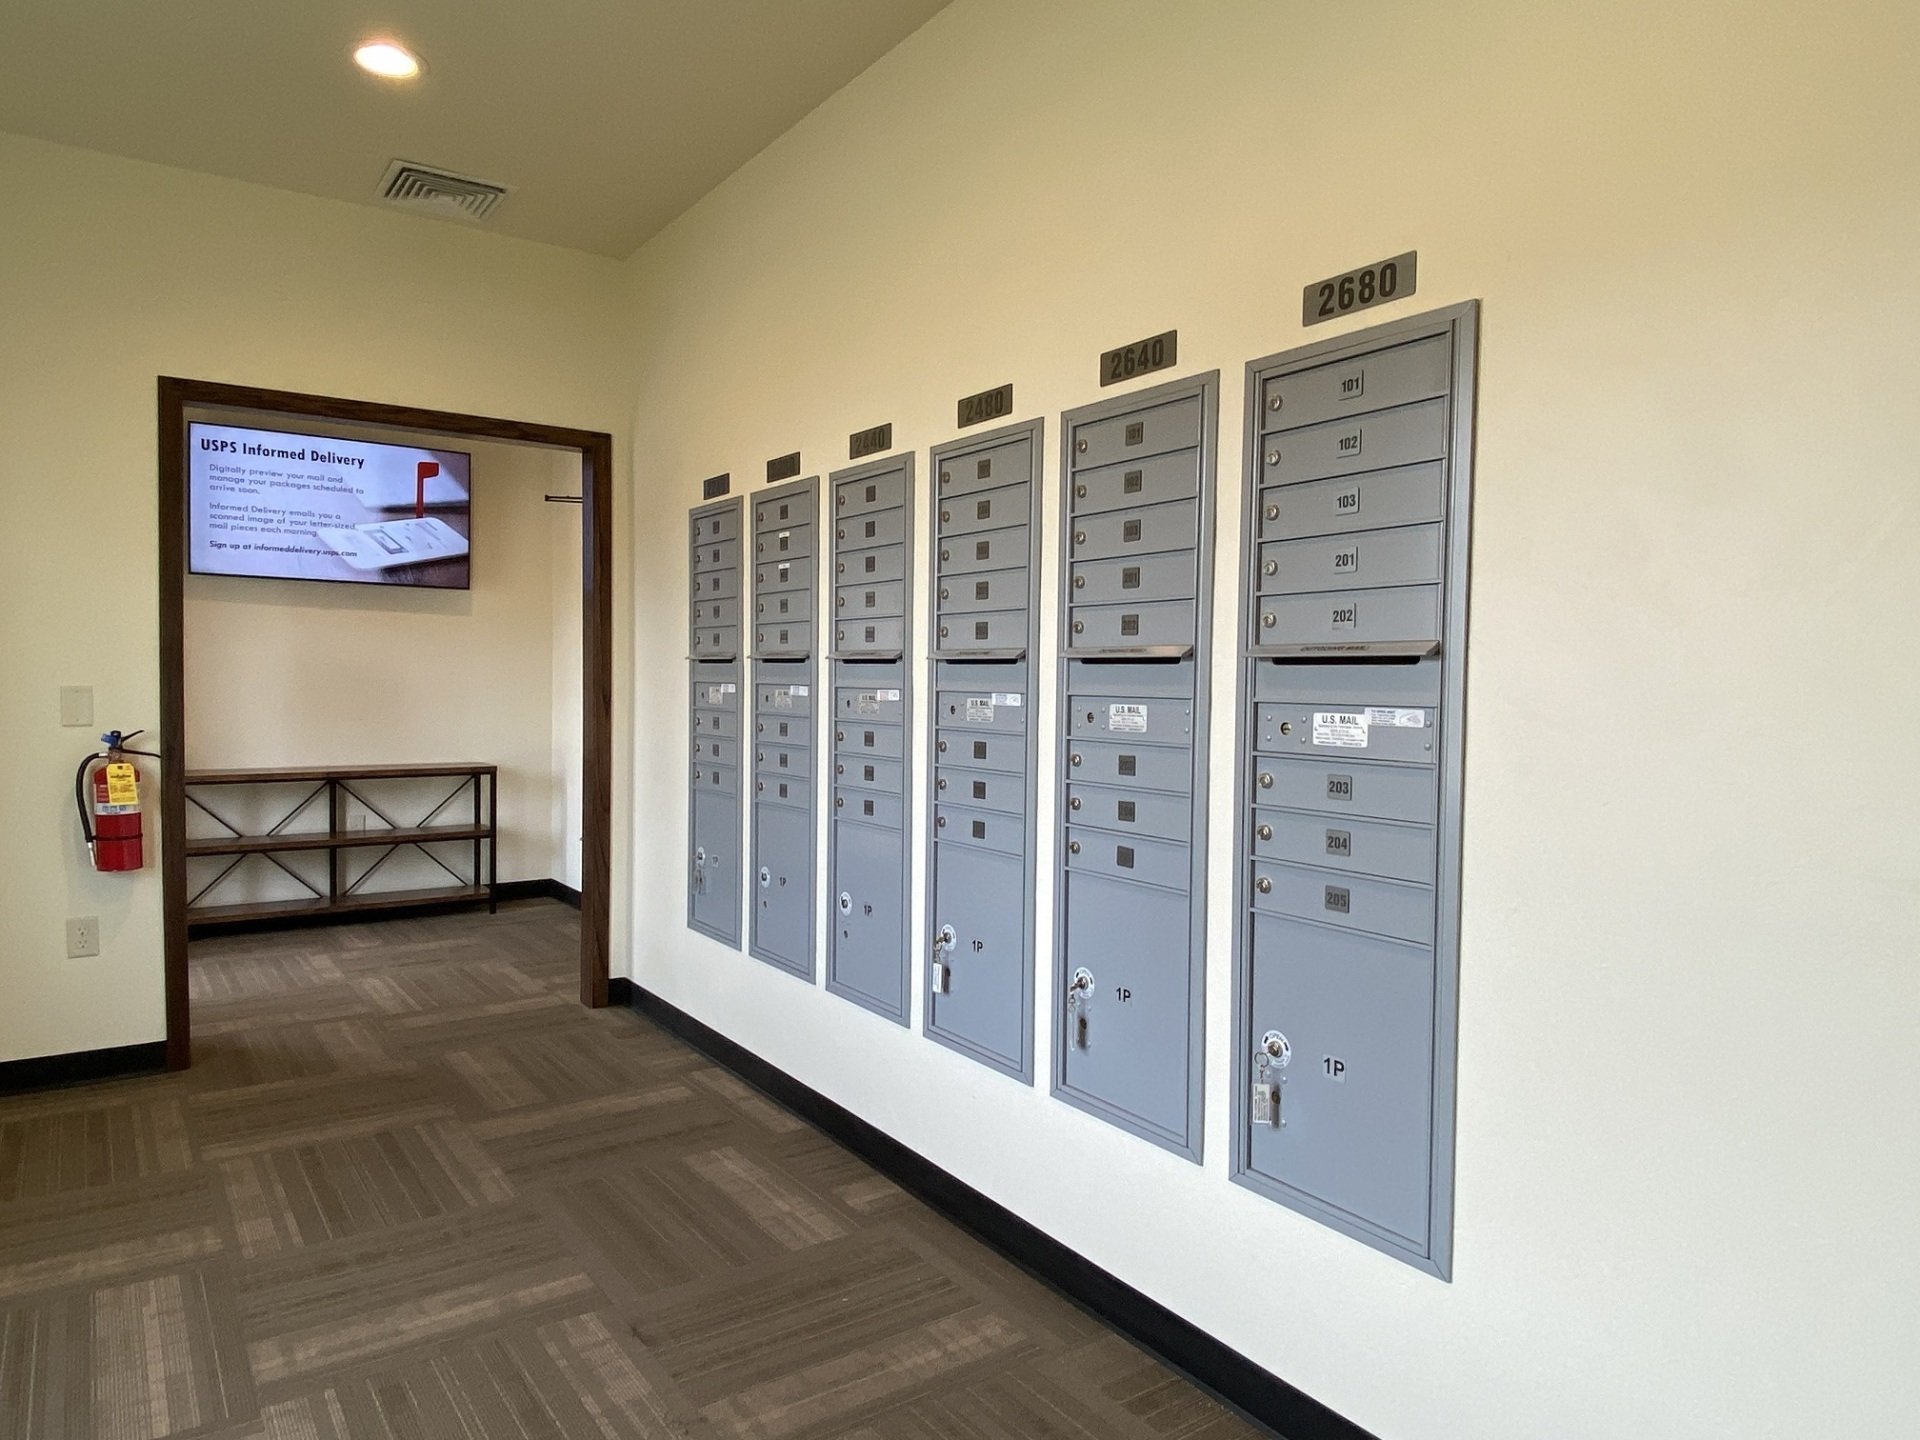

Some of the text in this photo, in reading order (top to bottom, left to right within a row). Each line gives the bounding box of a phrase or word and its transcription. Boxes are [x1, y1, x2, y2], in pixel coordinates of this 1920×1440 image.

[1317, 262, 1398, 317] 2680
[1110, 338, 1164, 380] 2640
[1341, 376, 1360, 393] 101
[966, 390, 1004, 423] 2480
[1339, 435, 1358, 452] 102
[201, 438, 365, 469] USPS Informed Delivery
[209, 464, 344, 484] Digitally preview your mail and
[209, 475, 245, 484] manage
[269, 480, 311, 491] packages
[313, 484, 354, 494] scheduled
[1337, 494, 1356, 509] 103
[209, 502, 249, 513] Informed
[251, 505, 286, 516] Delivery
[289, 510, 315, 518] emails
[209, 513, 245, 522] scanned
[248, 515, 274, 525] image
[310, 520, 356, 530] letter-sized
[209, 522, 228, 530] mail
[230, 524, 258, 532] pieces
[261, 526, 282, 534] each
[209, 540, 227, 550] Sign
[254, 543, 358, 557] informeddelivery.usps.com
[1335, 554, 1355, 568] 201
[1332, 609, 1353, 624] 202
[1322, 714, 1359, 725] U.S. MAIL
[1329, 781, 1349, 795] 203
[1327, 835, 1348, 850] 204
[1326, 893, 1347, 908] 205
[864, 904, 872, 916] 1P
[972, 940, 983, 953] 1P
[1116, 987, 1131, 1002] 1P
[1323, 1057, 1345, 1077] 1P
